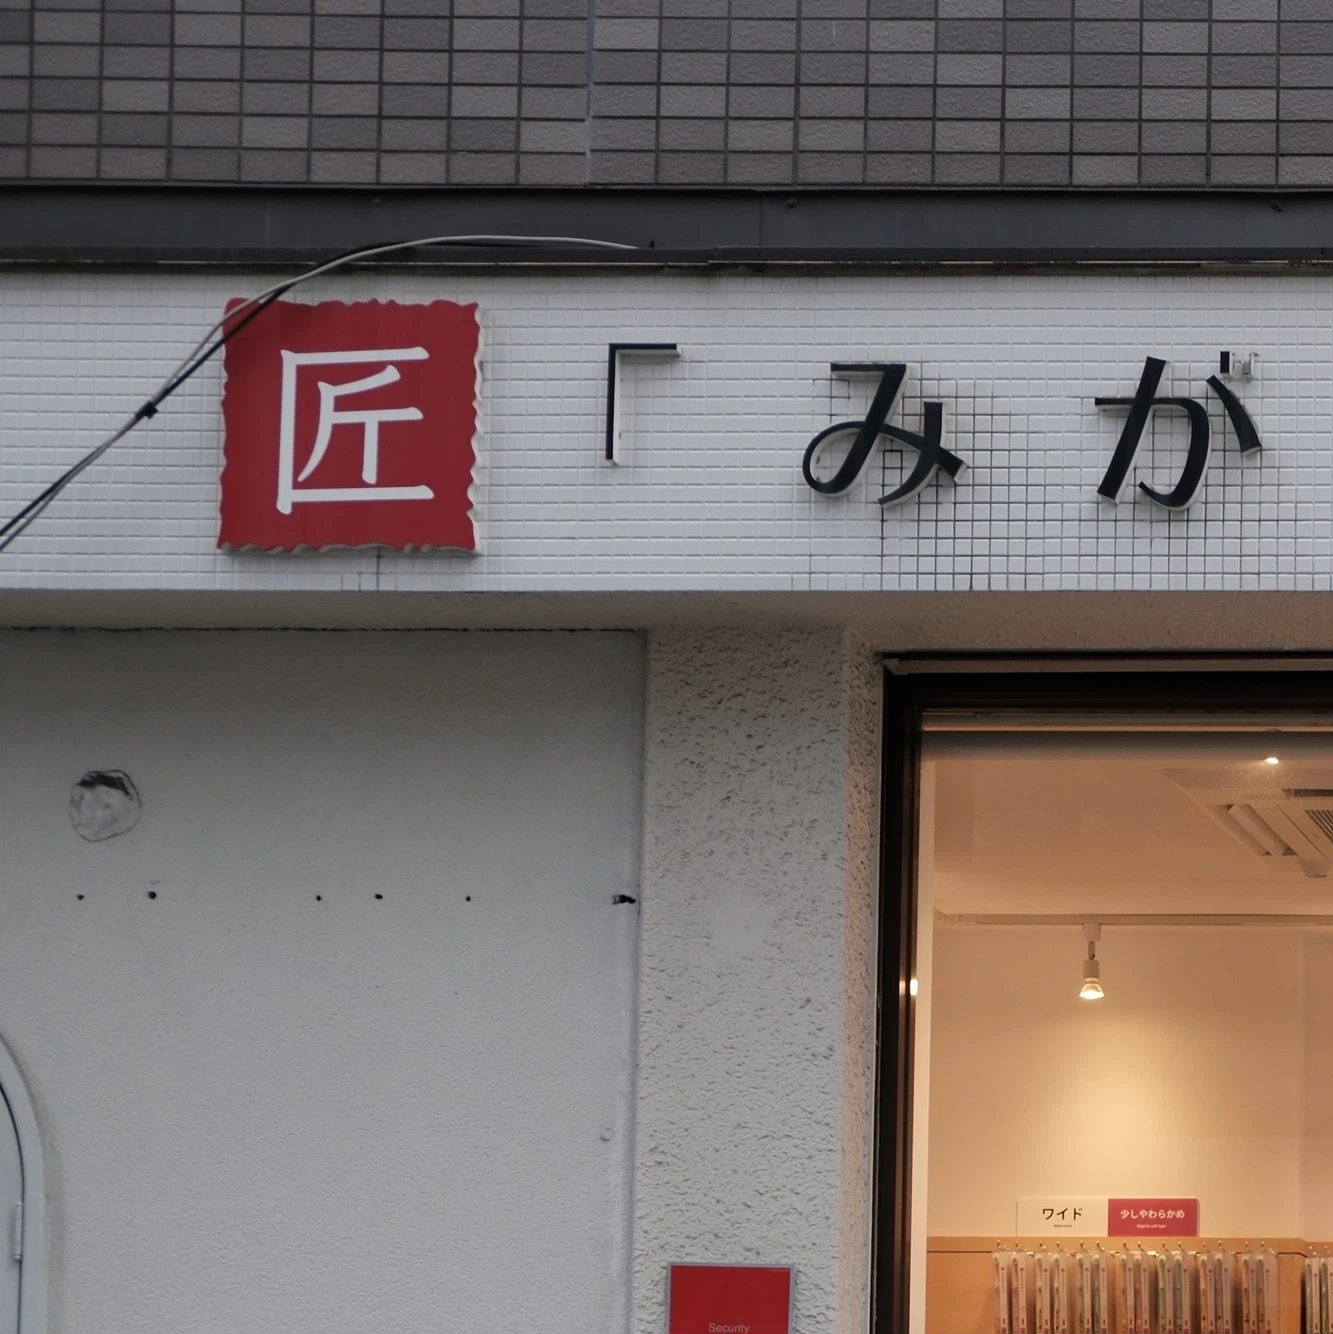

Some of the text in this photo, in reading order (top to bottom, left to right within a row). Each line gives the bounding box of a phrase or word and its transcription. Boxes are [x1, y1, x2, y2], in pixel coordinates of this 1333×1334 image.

[278, 346, 434, 515] 匠
[1041, 1207, 1084, 1221] ワイド
[1120, 1209, 1185, 1220] 少しやわらかめ
[708, 1322, 750, 1334] Security
